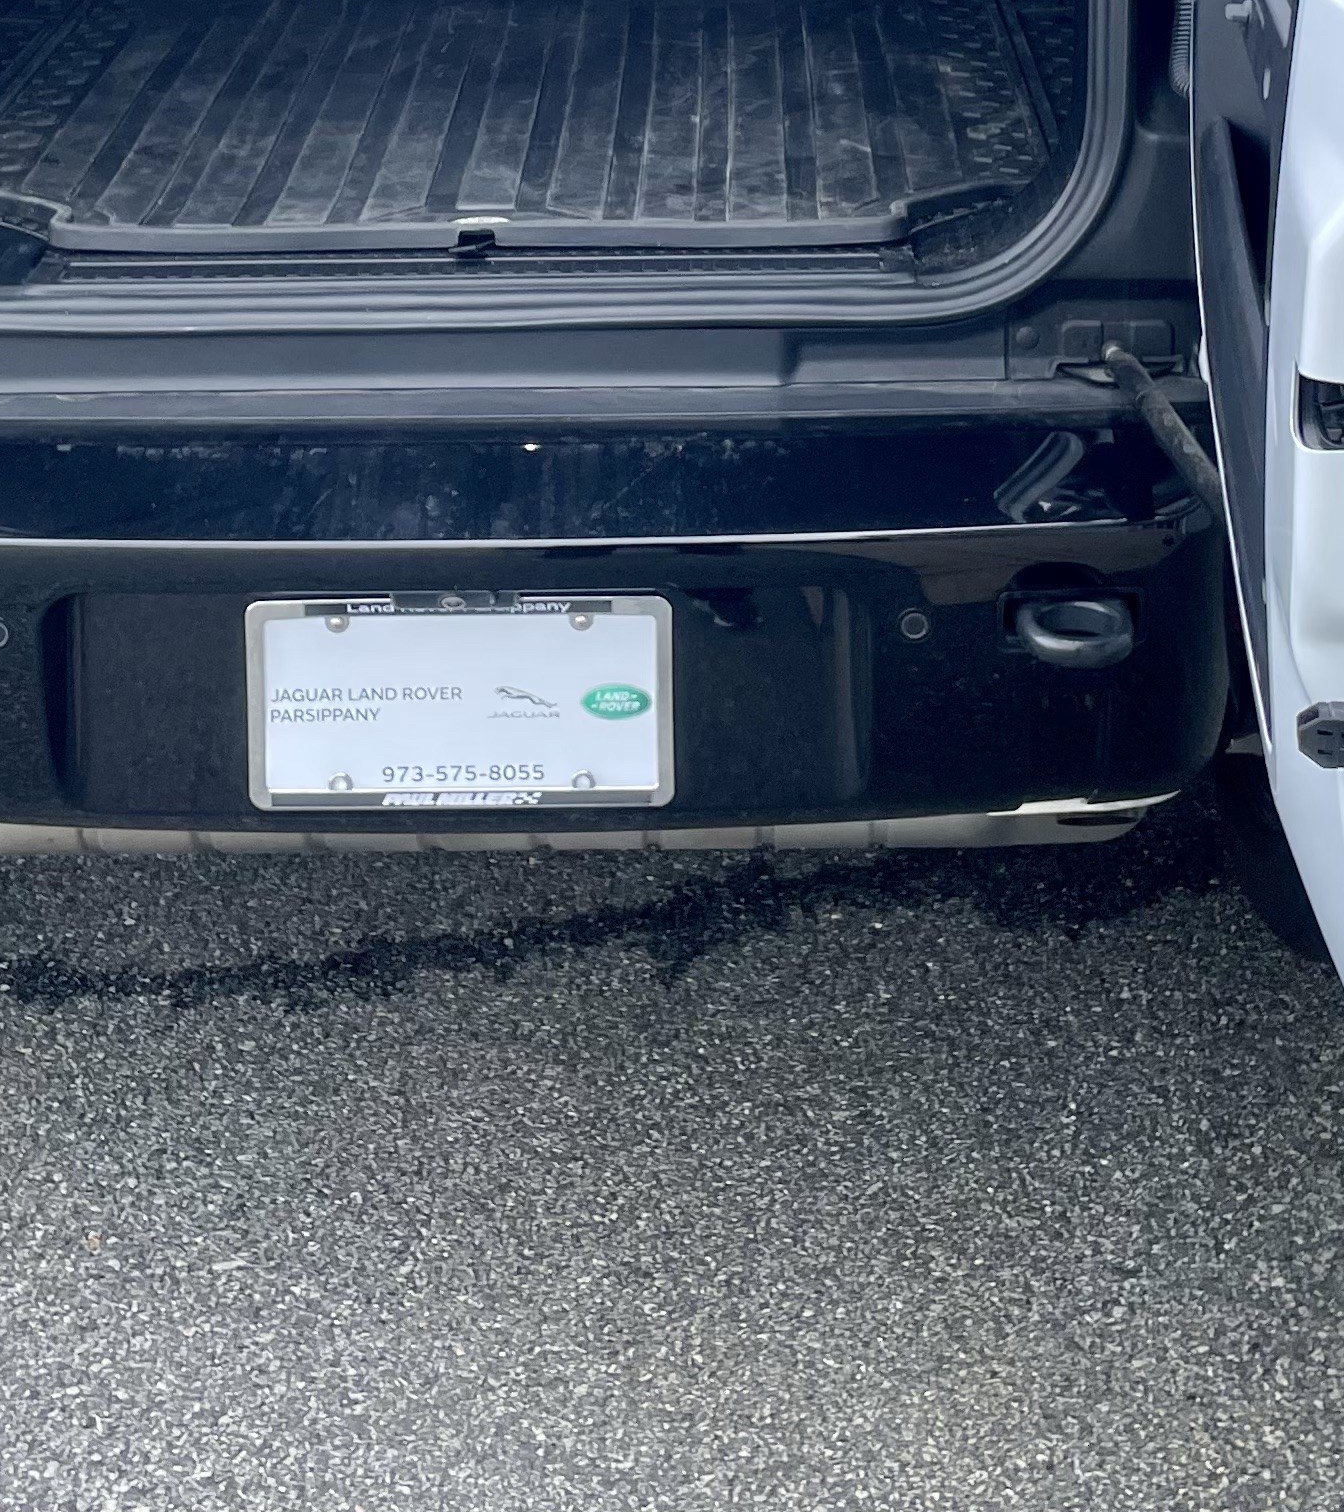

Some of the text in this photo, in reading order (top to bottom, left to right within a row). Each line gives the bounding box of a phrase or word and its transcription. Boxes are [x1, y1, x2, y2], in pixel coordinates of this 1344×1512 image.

[346, 602, 394, 613] Land
[271, 686, 463, 702] JAGUAR LAND ROVER
[270, 708, 381, 723] PARSIPPANY
[487, 711, 560, 719] JAGUAR
[382, 764, 545, 782] 973-575-8055
